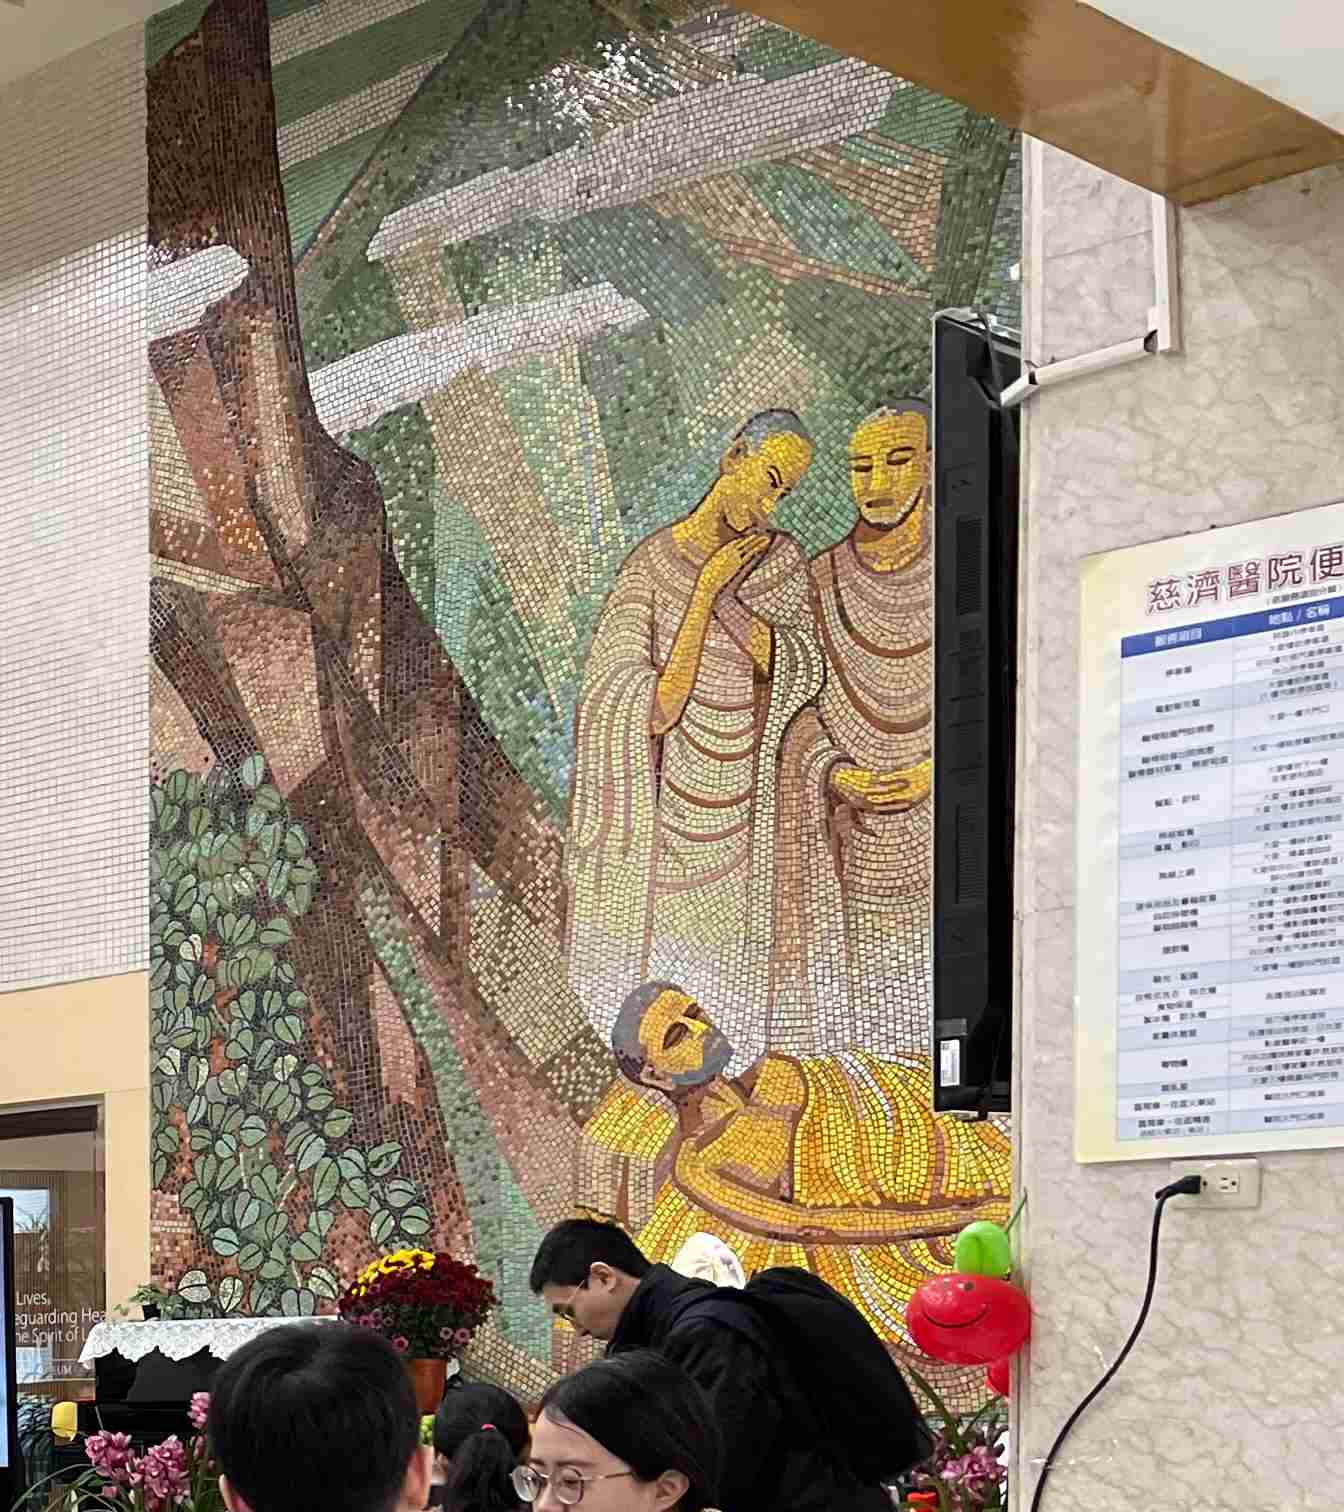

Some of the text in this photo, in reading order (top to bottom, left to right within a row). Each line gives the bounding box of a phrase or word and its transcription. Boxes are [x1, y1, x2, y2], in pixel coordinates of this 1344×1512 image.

[1147, 545, 1344, 614] 慈濟醫院便
[15, 1308, 106, 1328] eguarding Hea
